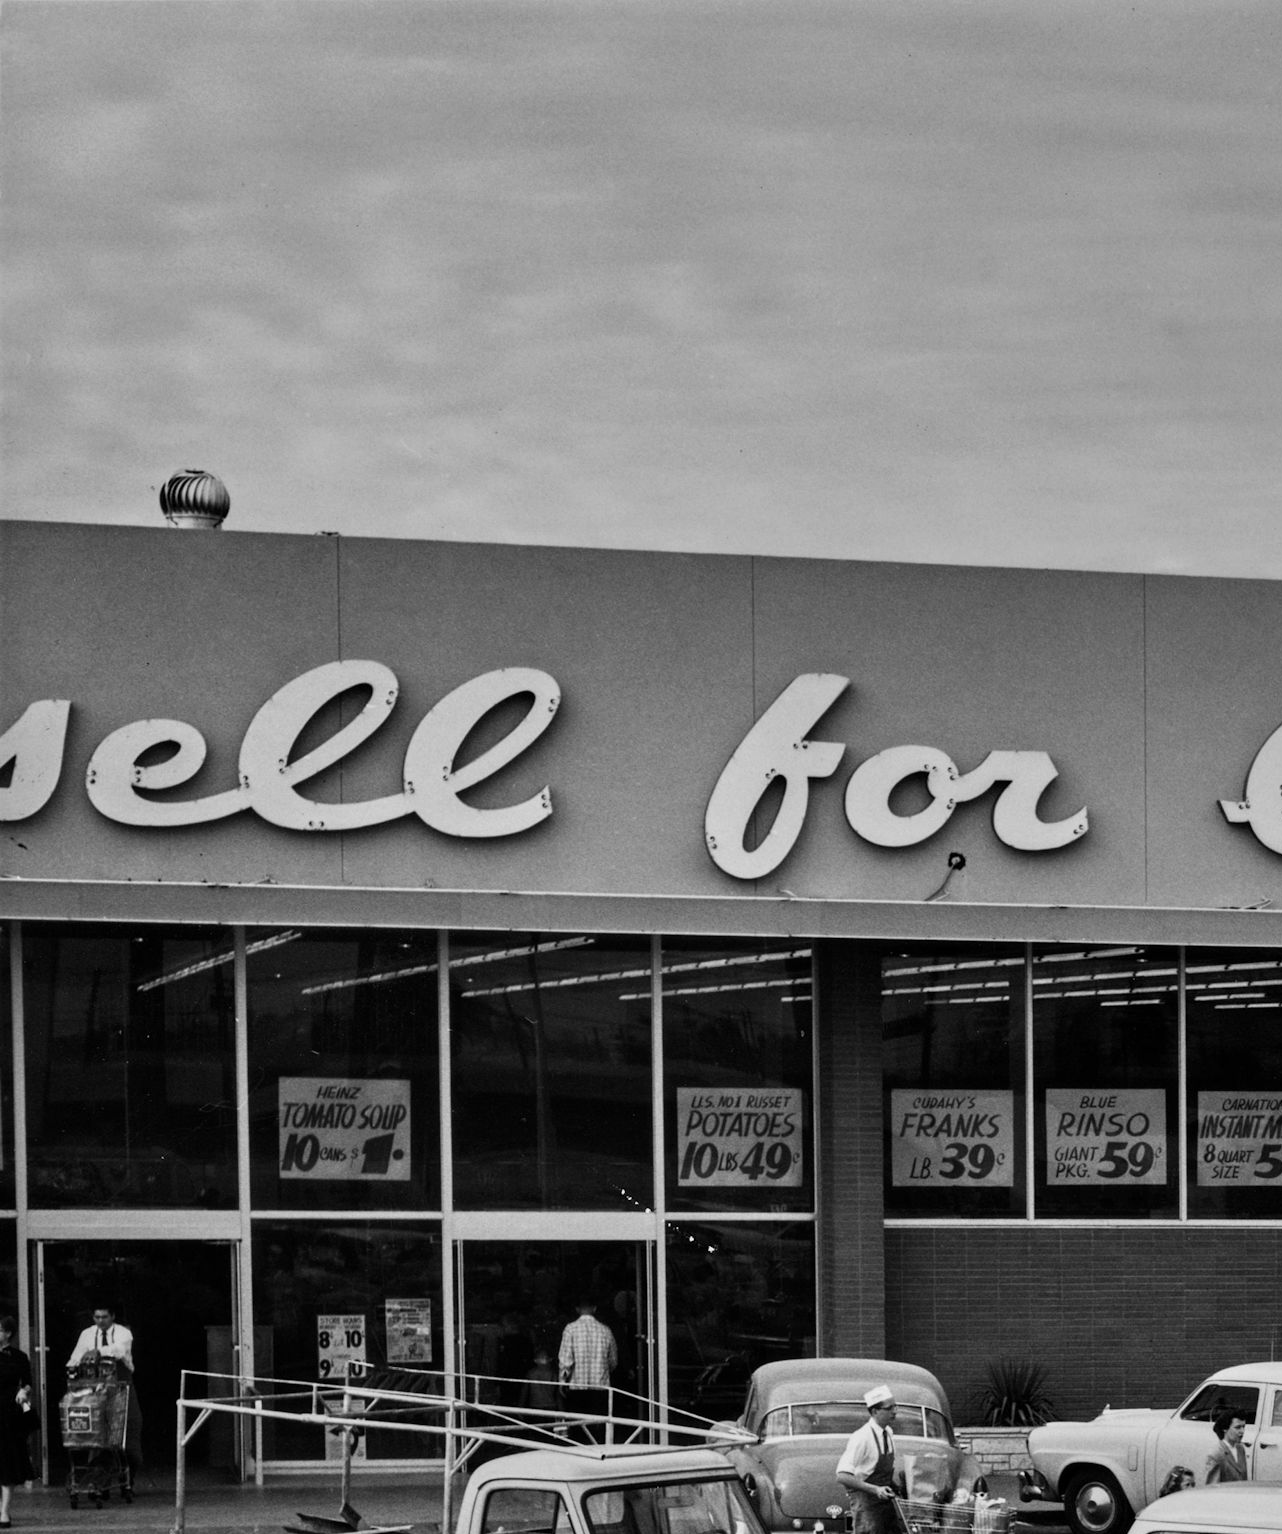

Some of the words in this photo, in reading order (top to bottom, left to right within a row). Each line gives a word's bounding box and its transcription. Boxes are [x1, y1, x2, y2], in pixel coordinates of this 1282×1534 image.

[704, 672, 1089, 880] for
[316, 1085, 362, 1099] HEINZ
[746, 1095, 793, 1109] RUSSET
[912, 1096, 976, 1110] CUDAHY'S
[1079, 1096, 1117, 1109] BLUE
[281, 1102, 356, 1129] TOMATO
[357, 1104, 407, 1130] SOUP
[685, 1111, 796, 1138] POTATOES
[900, 1113, 1001, 1138] FRANKS
[1056, 1112, 1149, 1138] RINSO
[1200, 1115, 1263, 1139] INSTANT
[281, 1133, 320, 1172] 10
[320, 1146, 346, 1162] CANS
[680, 1142, 718, 1180] 10
[718, 1152, 738, 1172] LBS
[1054, 1146, 1099, 1162] GIANT
[1203, 1144, 1216, 1164] 8
[1217, 1150, 1252, 1164] QUART
[909, 1156, 934, 1180] LB.
[1055, 1164, 1091, 1178] PKG.
[1211, 1166, 1240, 1179] SIZE
[320, 1331, 331, 1349] 8
[345, 1330, 362, 1348] 10
[320, 1359, 331, 1377] 9
